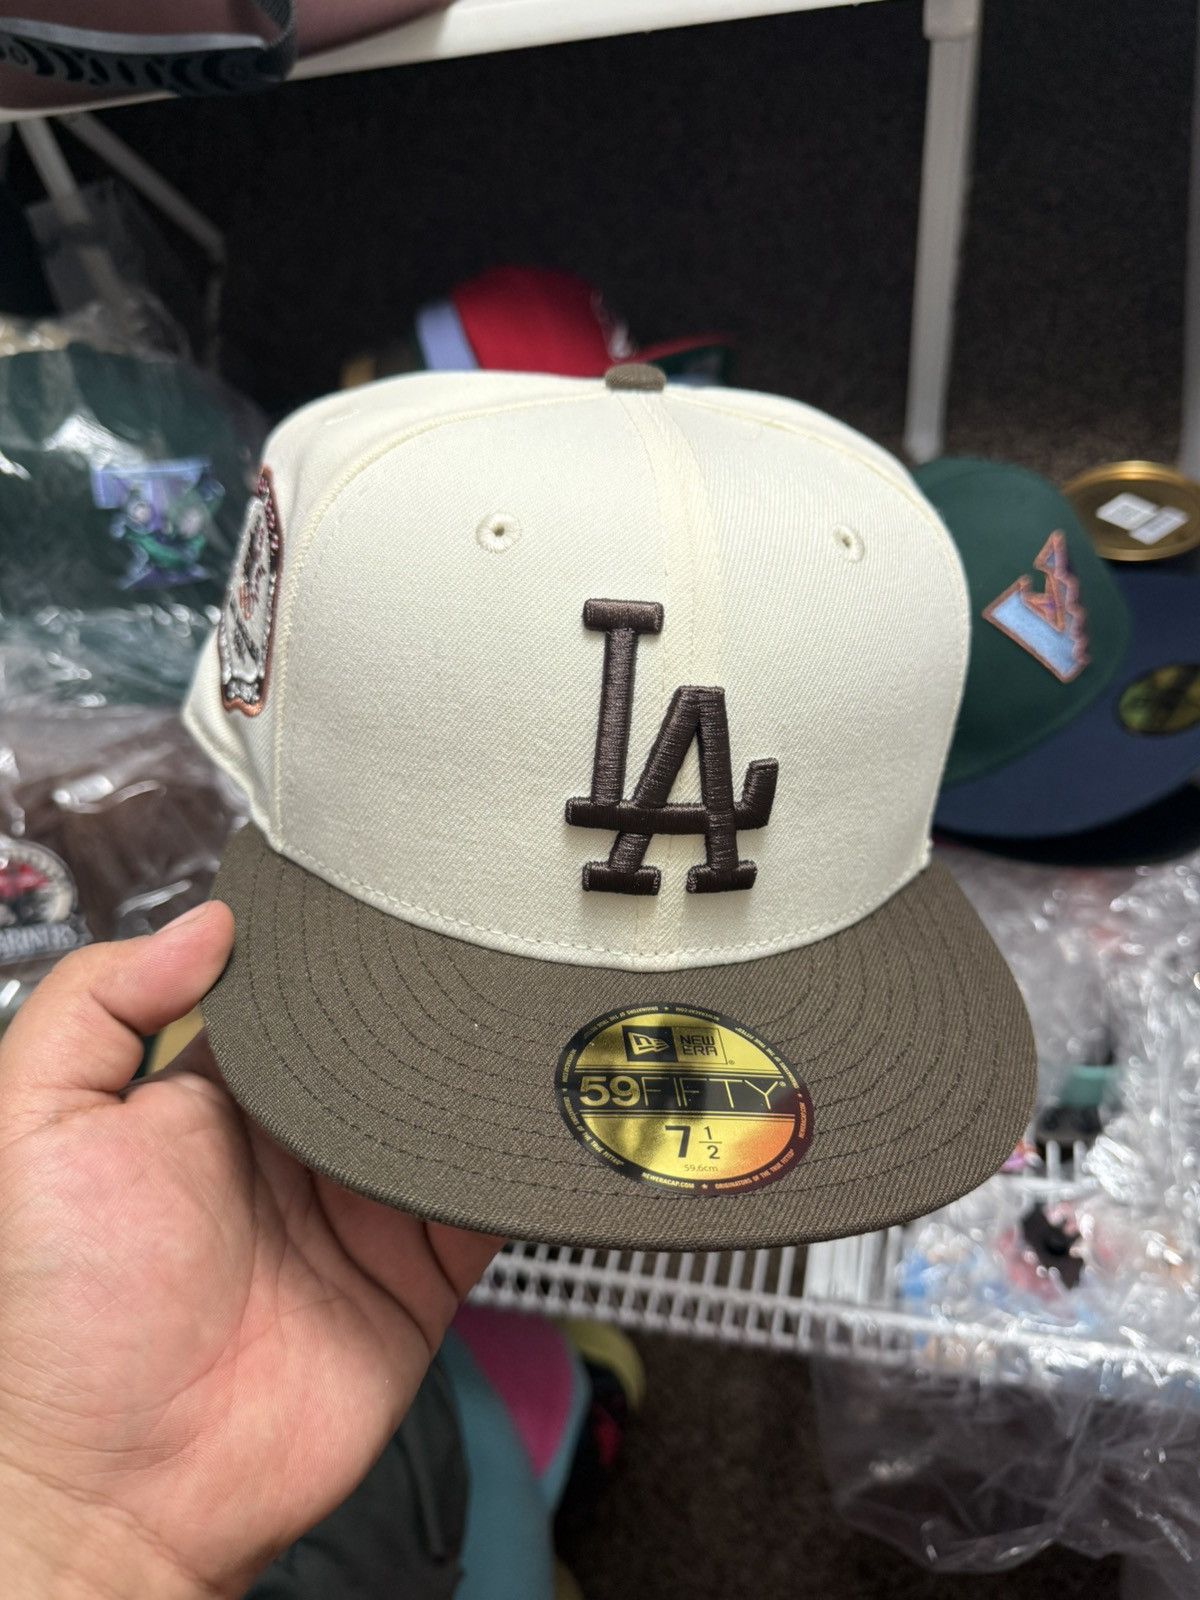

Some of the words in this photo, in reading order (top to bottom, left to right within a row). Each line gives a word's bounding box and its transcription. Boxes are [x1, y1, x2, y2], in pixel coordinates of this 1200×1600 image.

[565, 598, 779, 896] LA
[680, 1035, 715, 1046] NEW
[682, 1045, 718, 1056] ERA
[664, 1125, 691, 1158] 7
[684, 1164, 719, 1172] 59.6cm
[642, 1171, 695, 1188] NEWERACAP.COM
